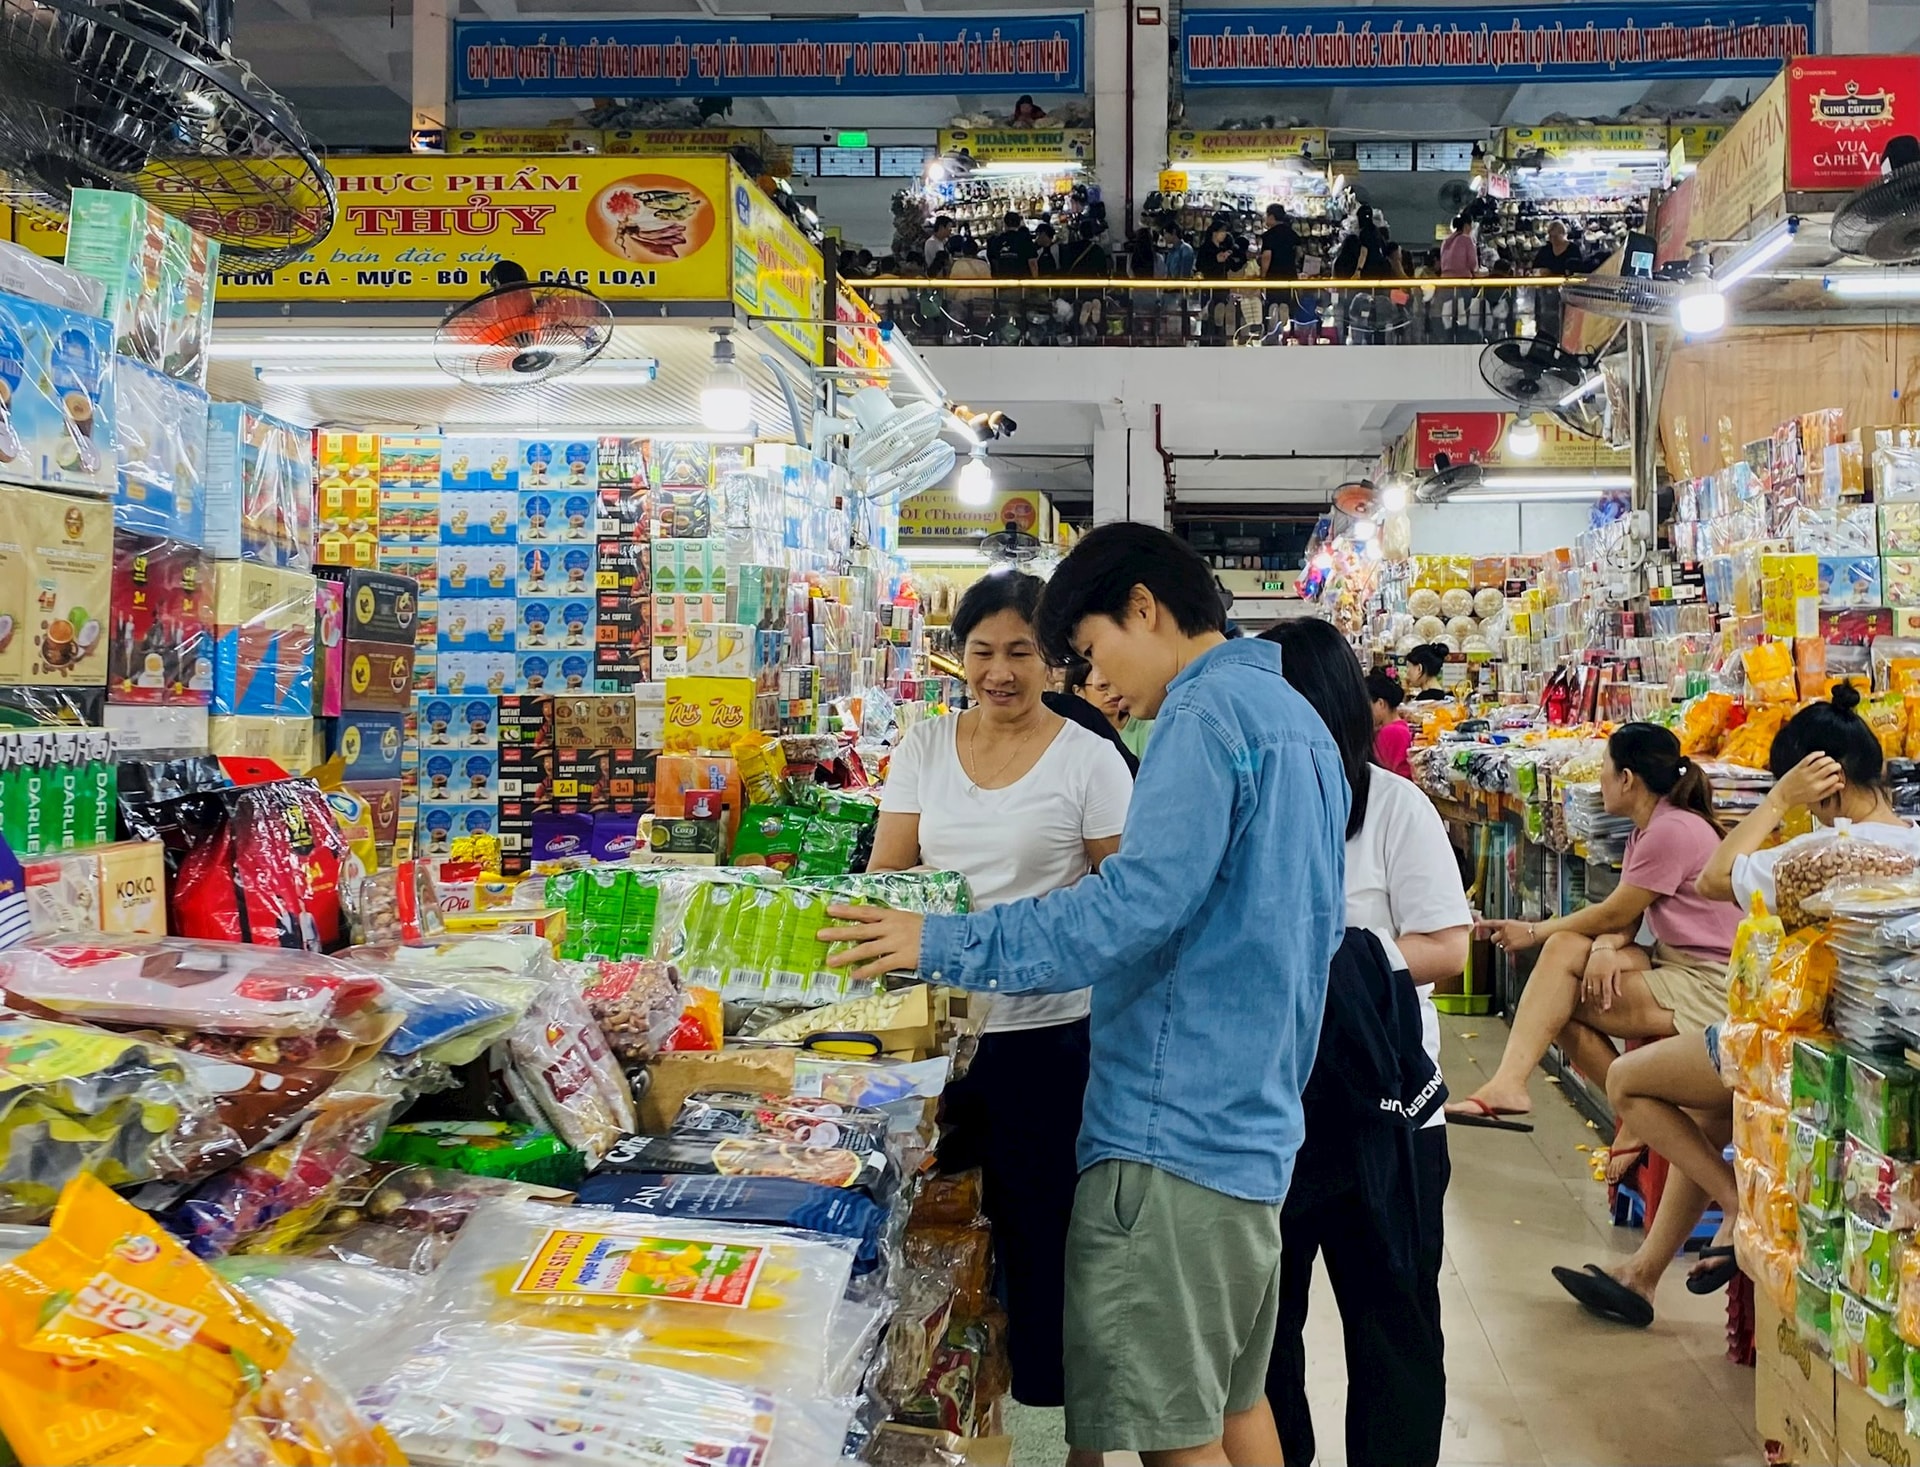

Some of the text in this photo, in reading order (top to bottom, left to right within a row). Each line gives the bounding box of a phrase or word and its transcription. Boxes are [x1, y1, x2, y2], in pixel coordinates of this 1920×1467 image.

[1189, 16, 1808, 73] MUA BÁN HÀNG HÓA CÓ NGUỒN GỐC XUẤT XỨ RÕ RÀNG LÀ QUYỀN LỢI VÀ NGHĨA VỤ CỦA THƯƠNG NHÂN VÀ KHÁCH HÀNG
[468, 41, 491, 88] CHỢ
[492, 38, 515, 79] HÀN
[516, 33, 550, 86] QUYẾT
[551, 37, 577, 79] TÂM
[578, 36, 600, 78] GIỮ
[600, 36, 629, 78] VỮNG
[631, 44, 661, 78] DANH
[662, 35, 689, 86] HIỆU
[722, 36, 745, 77] VĂN
[747, 43, 777, 77] MINH
[777, 38, 822, 77] THƯƠNG
[854, 42, 870, 76] DO
[871, 42, 902, 77] UBND
[903, 33, 940, 76] THÀNH
[941, 28, 967, 75] PHỐ
[967, 32, 984, 75] ĐÀ
[984, 27, 1015, 75] NẴNG
[1016, 39, 1037, 74] GHI
[1038, 30, 1069, 82] NHẬN
[1848, 105, 1882, 114] COFFEE
[1837, 141, 1868, 153] VUA
[1813, 152, 1832, 167] CÀ
[1834, 153, 1859, 166] PHÊ
[446, 167, 581, 193] PHẨM
[1164, 179, 1184, 190] 257
[345, 195, 557, 237] THỦY
[329, 245, 380, 264] bán
[394, 246, 448, 269] đặc
[455, 247, 503, 264] sản
[298, 268, 331, 285] CÁ
[356, 268, 413, 290] MỰC
[437, 266, 469, 286] BÒ
[599, 268, 657, 290] LOẠI
[1265, 582, 1281, 590] EXIT
[612, 613, 632, 621] COFFEE
[500, 716, 519, 724] COFFEE
[559, 765, 596, 773] BLACK COFFEE
[627, 766, 648, 774] COFFEE
[27, 777, 42, 854] DARLIE
[62, 775, 76, 849] DARLIE
[95, 772, 109, 844] DARLIE
[675, 826, 695, 835] Cozy
[572, 1261, 600, 1286] Apple
